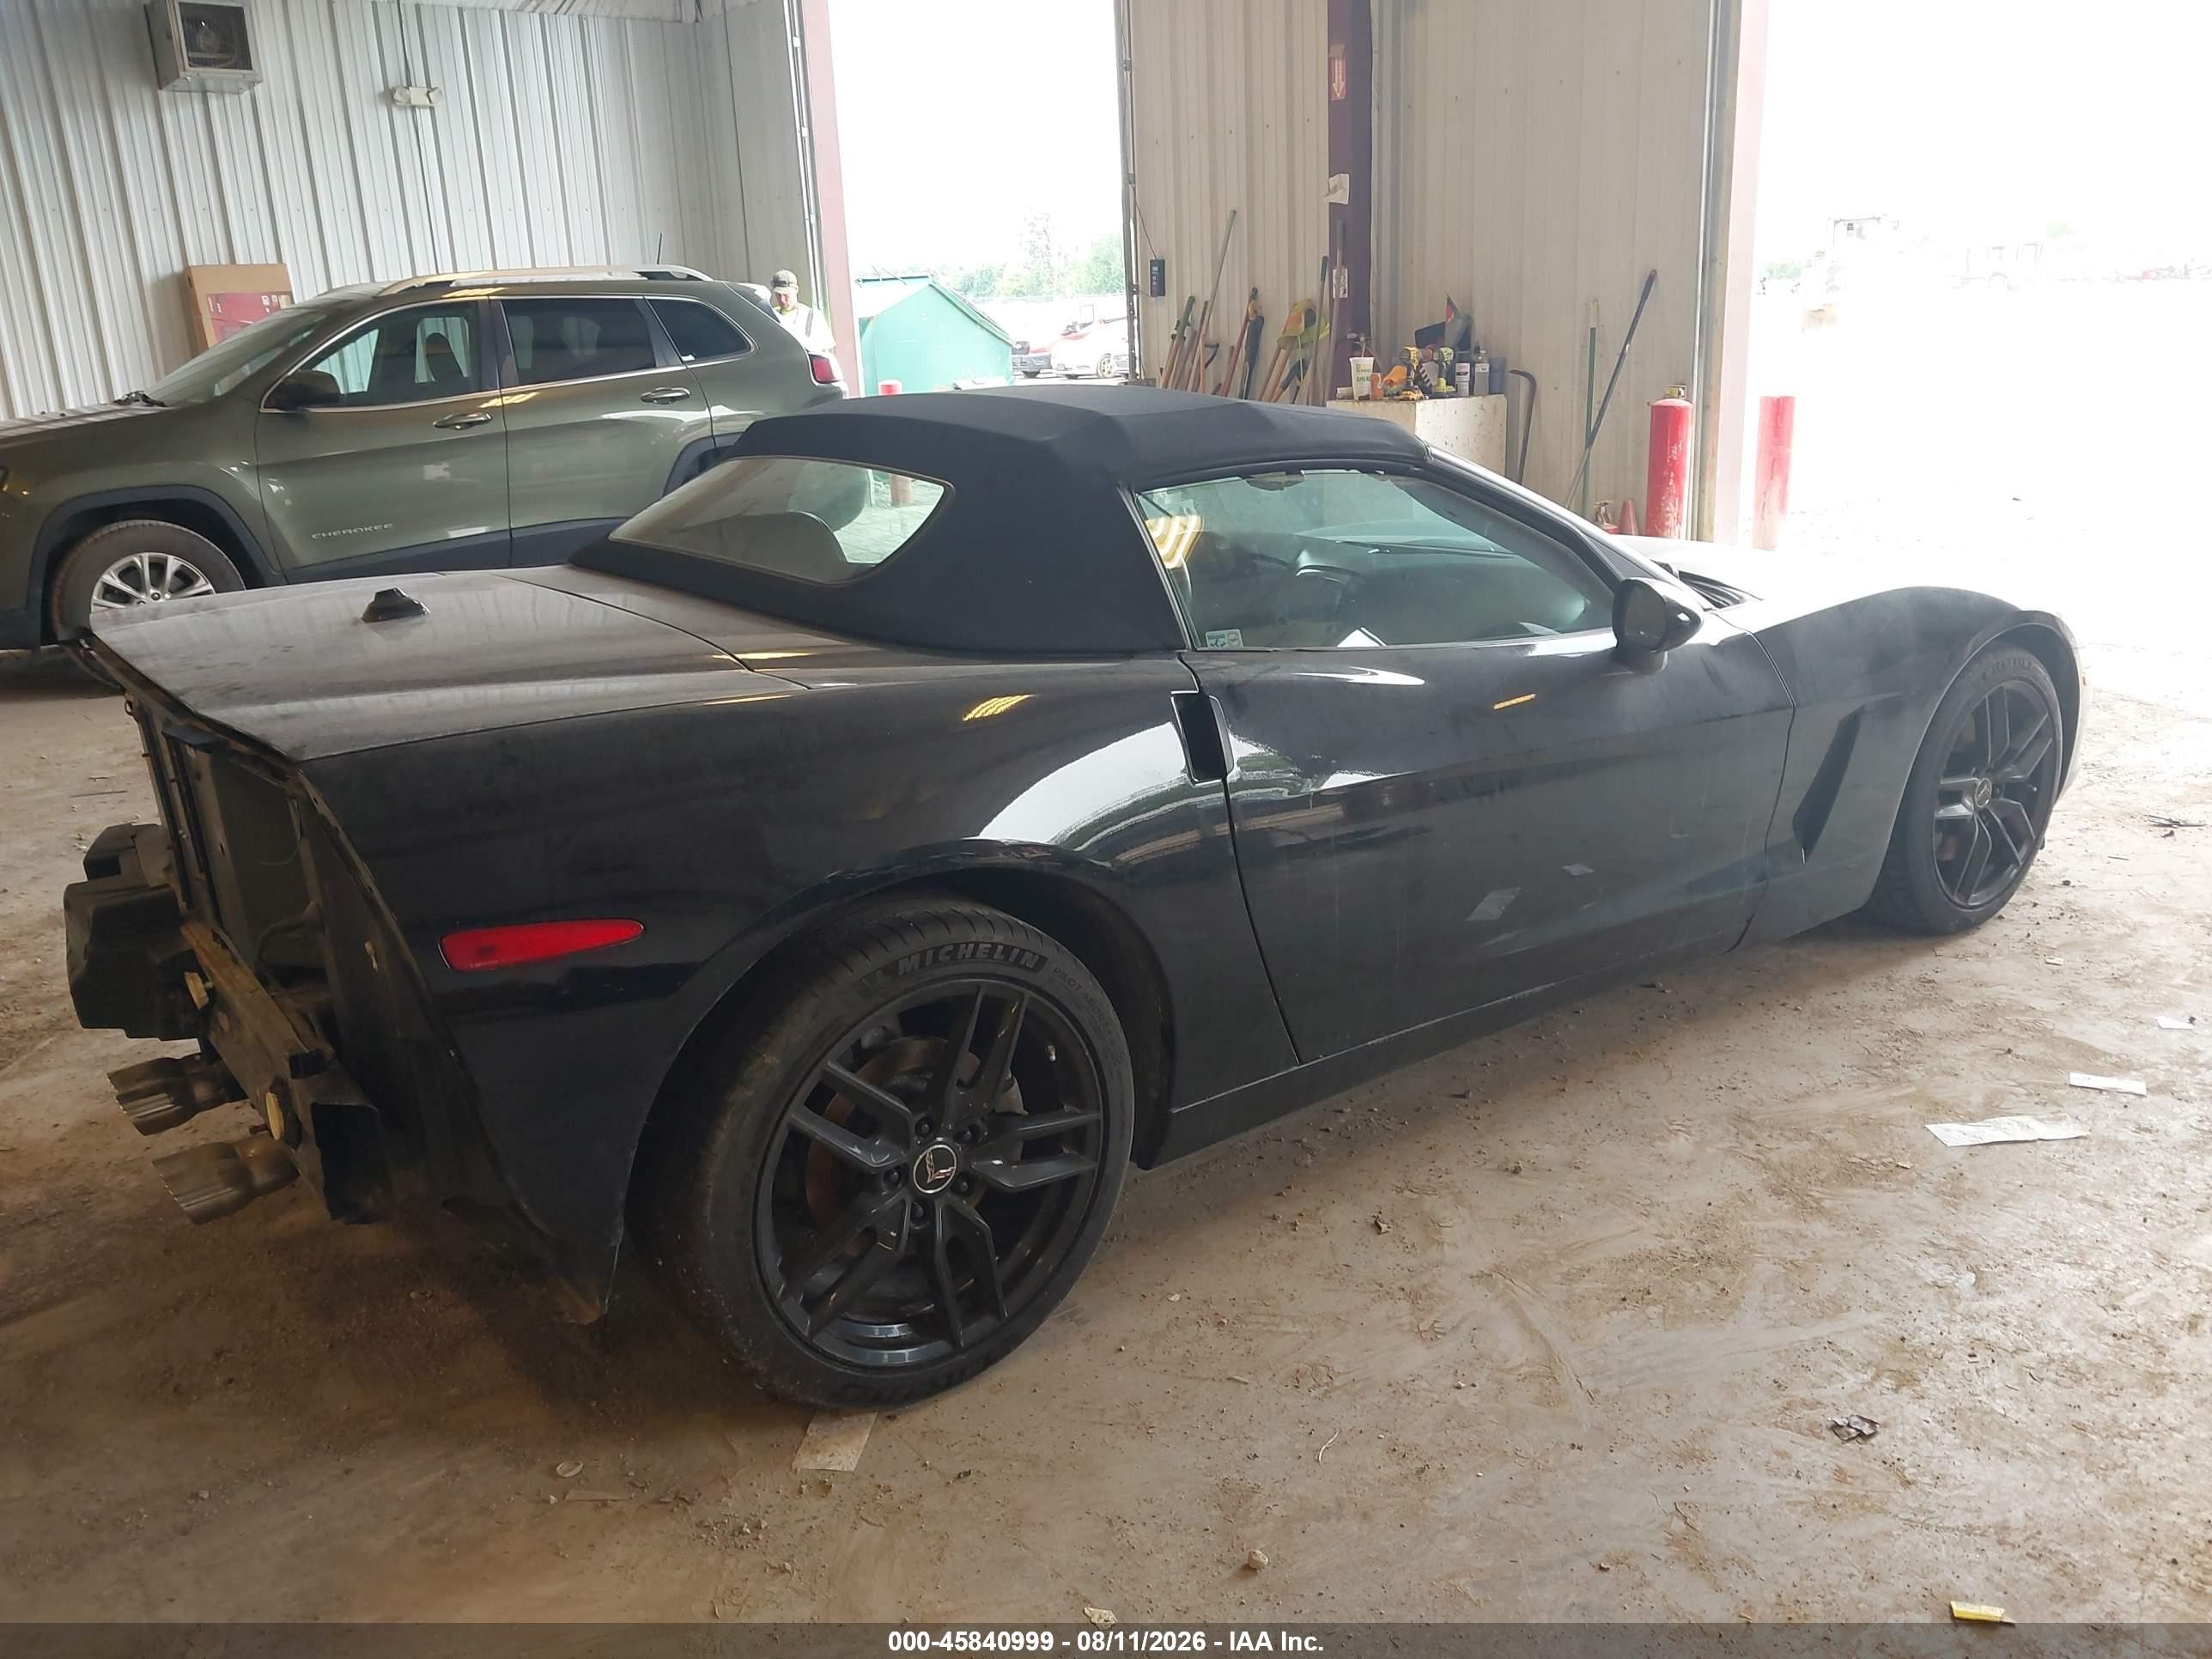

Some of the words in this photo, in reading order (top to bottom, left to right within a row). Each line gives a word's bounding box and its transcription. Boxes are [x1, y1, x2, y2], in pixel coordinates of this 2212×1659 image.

[310, 523, 393, 539] CHEROKEE
[898, 943, 1041, 975] MICHELIN
[1053, 967, 1083, 991] PILOT
